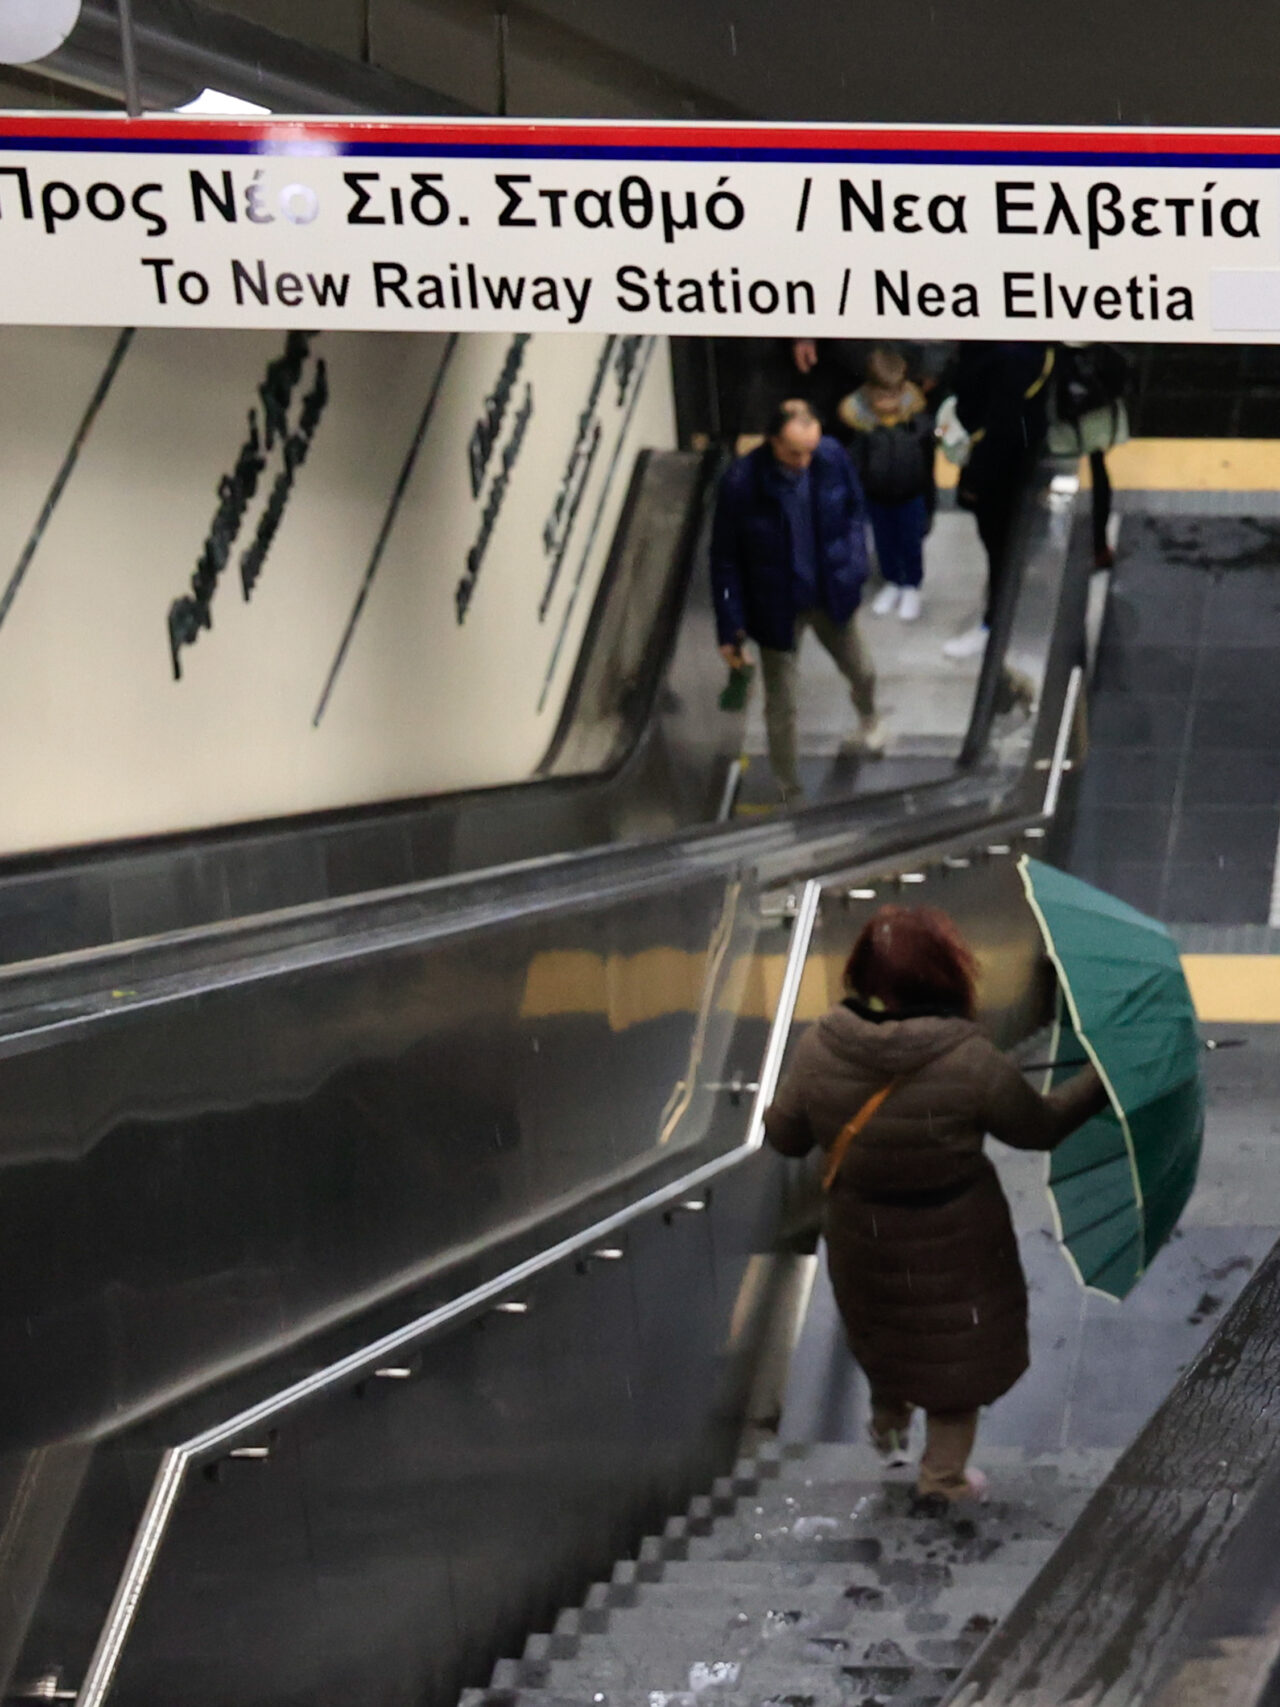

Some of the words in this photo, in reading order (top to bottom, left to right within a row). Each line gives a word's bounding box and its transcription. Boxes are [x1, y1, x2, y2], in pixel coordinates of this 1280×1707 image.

[0, 166, 168, 237] Προς
[189, 168, 320, 224] Νέο
[343, 172, 470, 227] Σιδ.
[495, 174, 745, 244] Σταθμό
[796, 177, 812, 232] /
[840, 178, 968, 234] Νεα
[995, 181, 1260, 250] Ελβετία
[141, 258, 209, 306] To
[231, 259, 350, 308] New
[373, 261, 592, 325] Railway
[616, 265, 816, 316] Station
[838, 268, 851, 316] /
[875, 269, 980, 318] Nea
[1003, 272, 1194, 321] Elvetia
